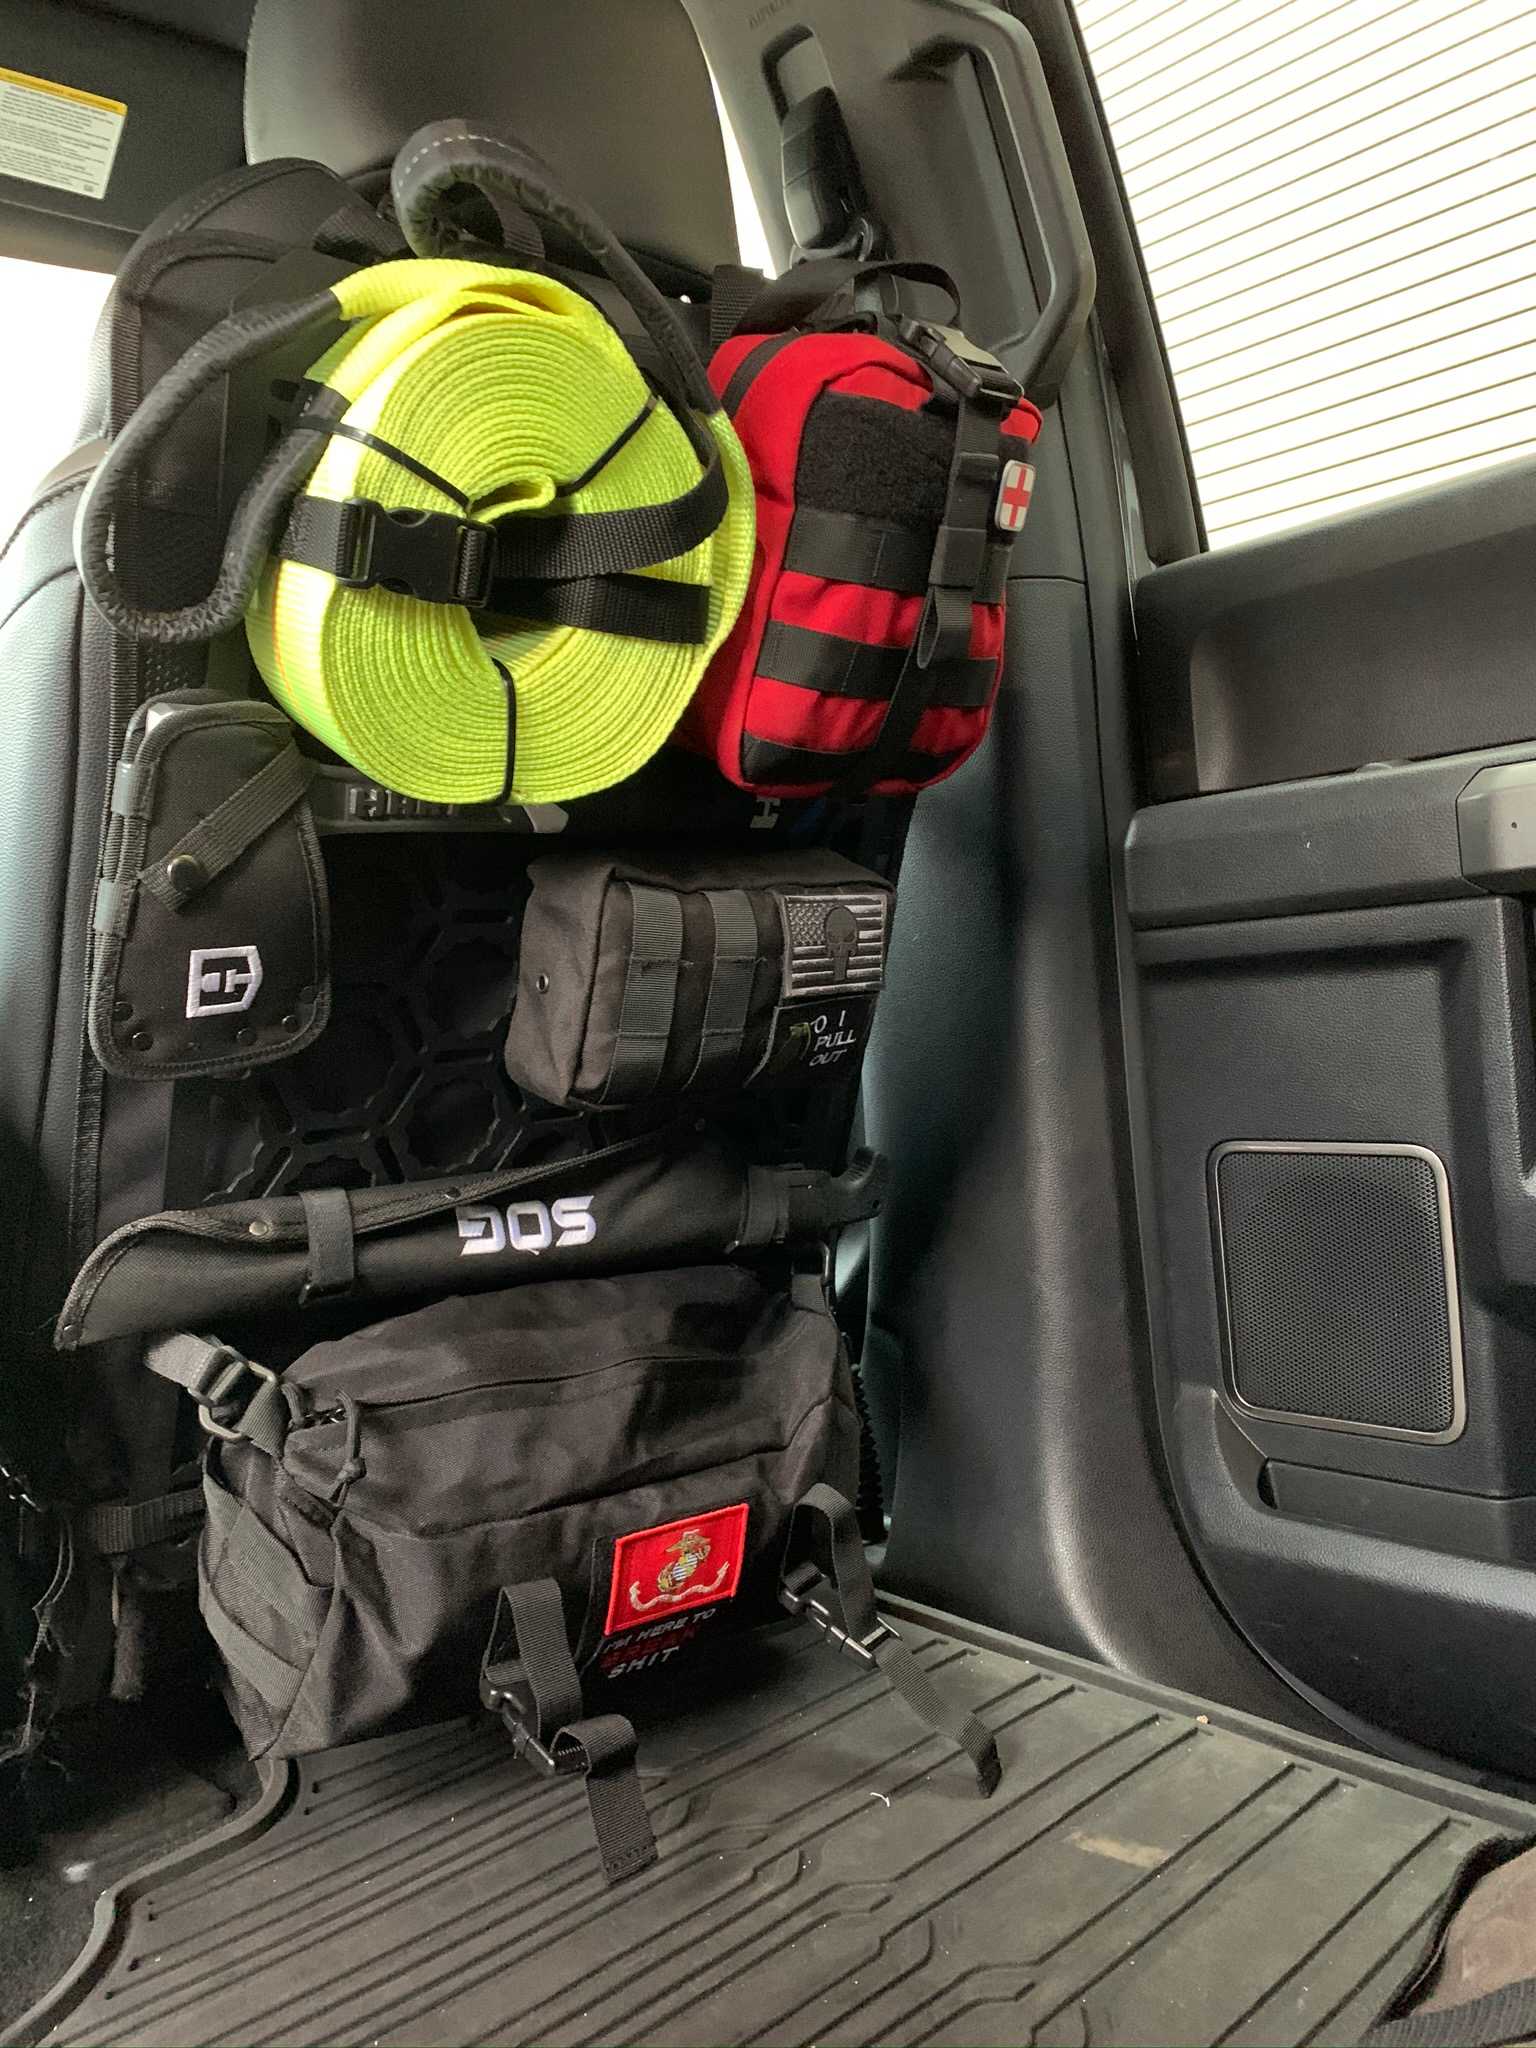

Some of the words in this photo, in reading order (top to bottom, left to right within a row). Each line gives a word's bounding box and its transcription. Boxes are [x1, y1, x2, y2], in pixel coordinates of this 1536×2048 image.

[813, 1028, 857, 1052] PULL
[809, 1048, 848, 1067] OUT
[635, 1616, 689, 1642] HERE
[691, 1607, 717, 1623] TO
[607, 1645, 680, 1679] SHIT
